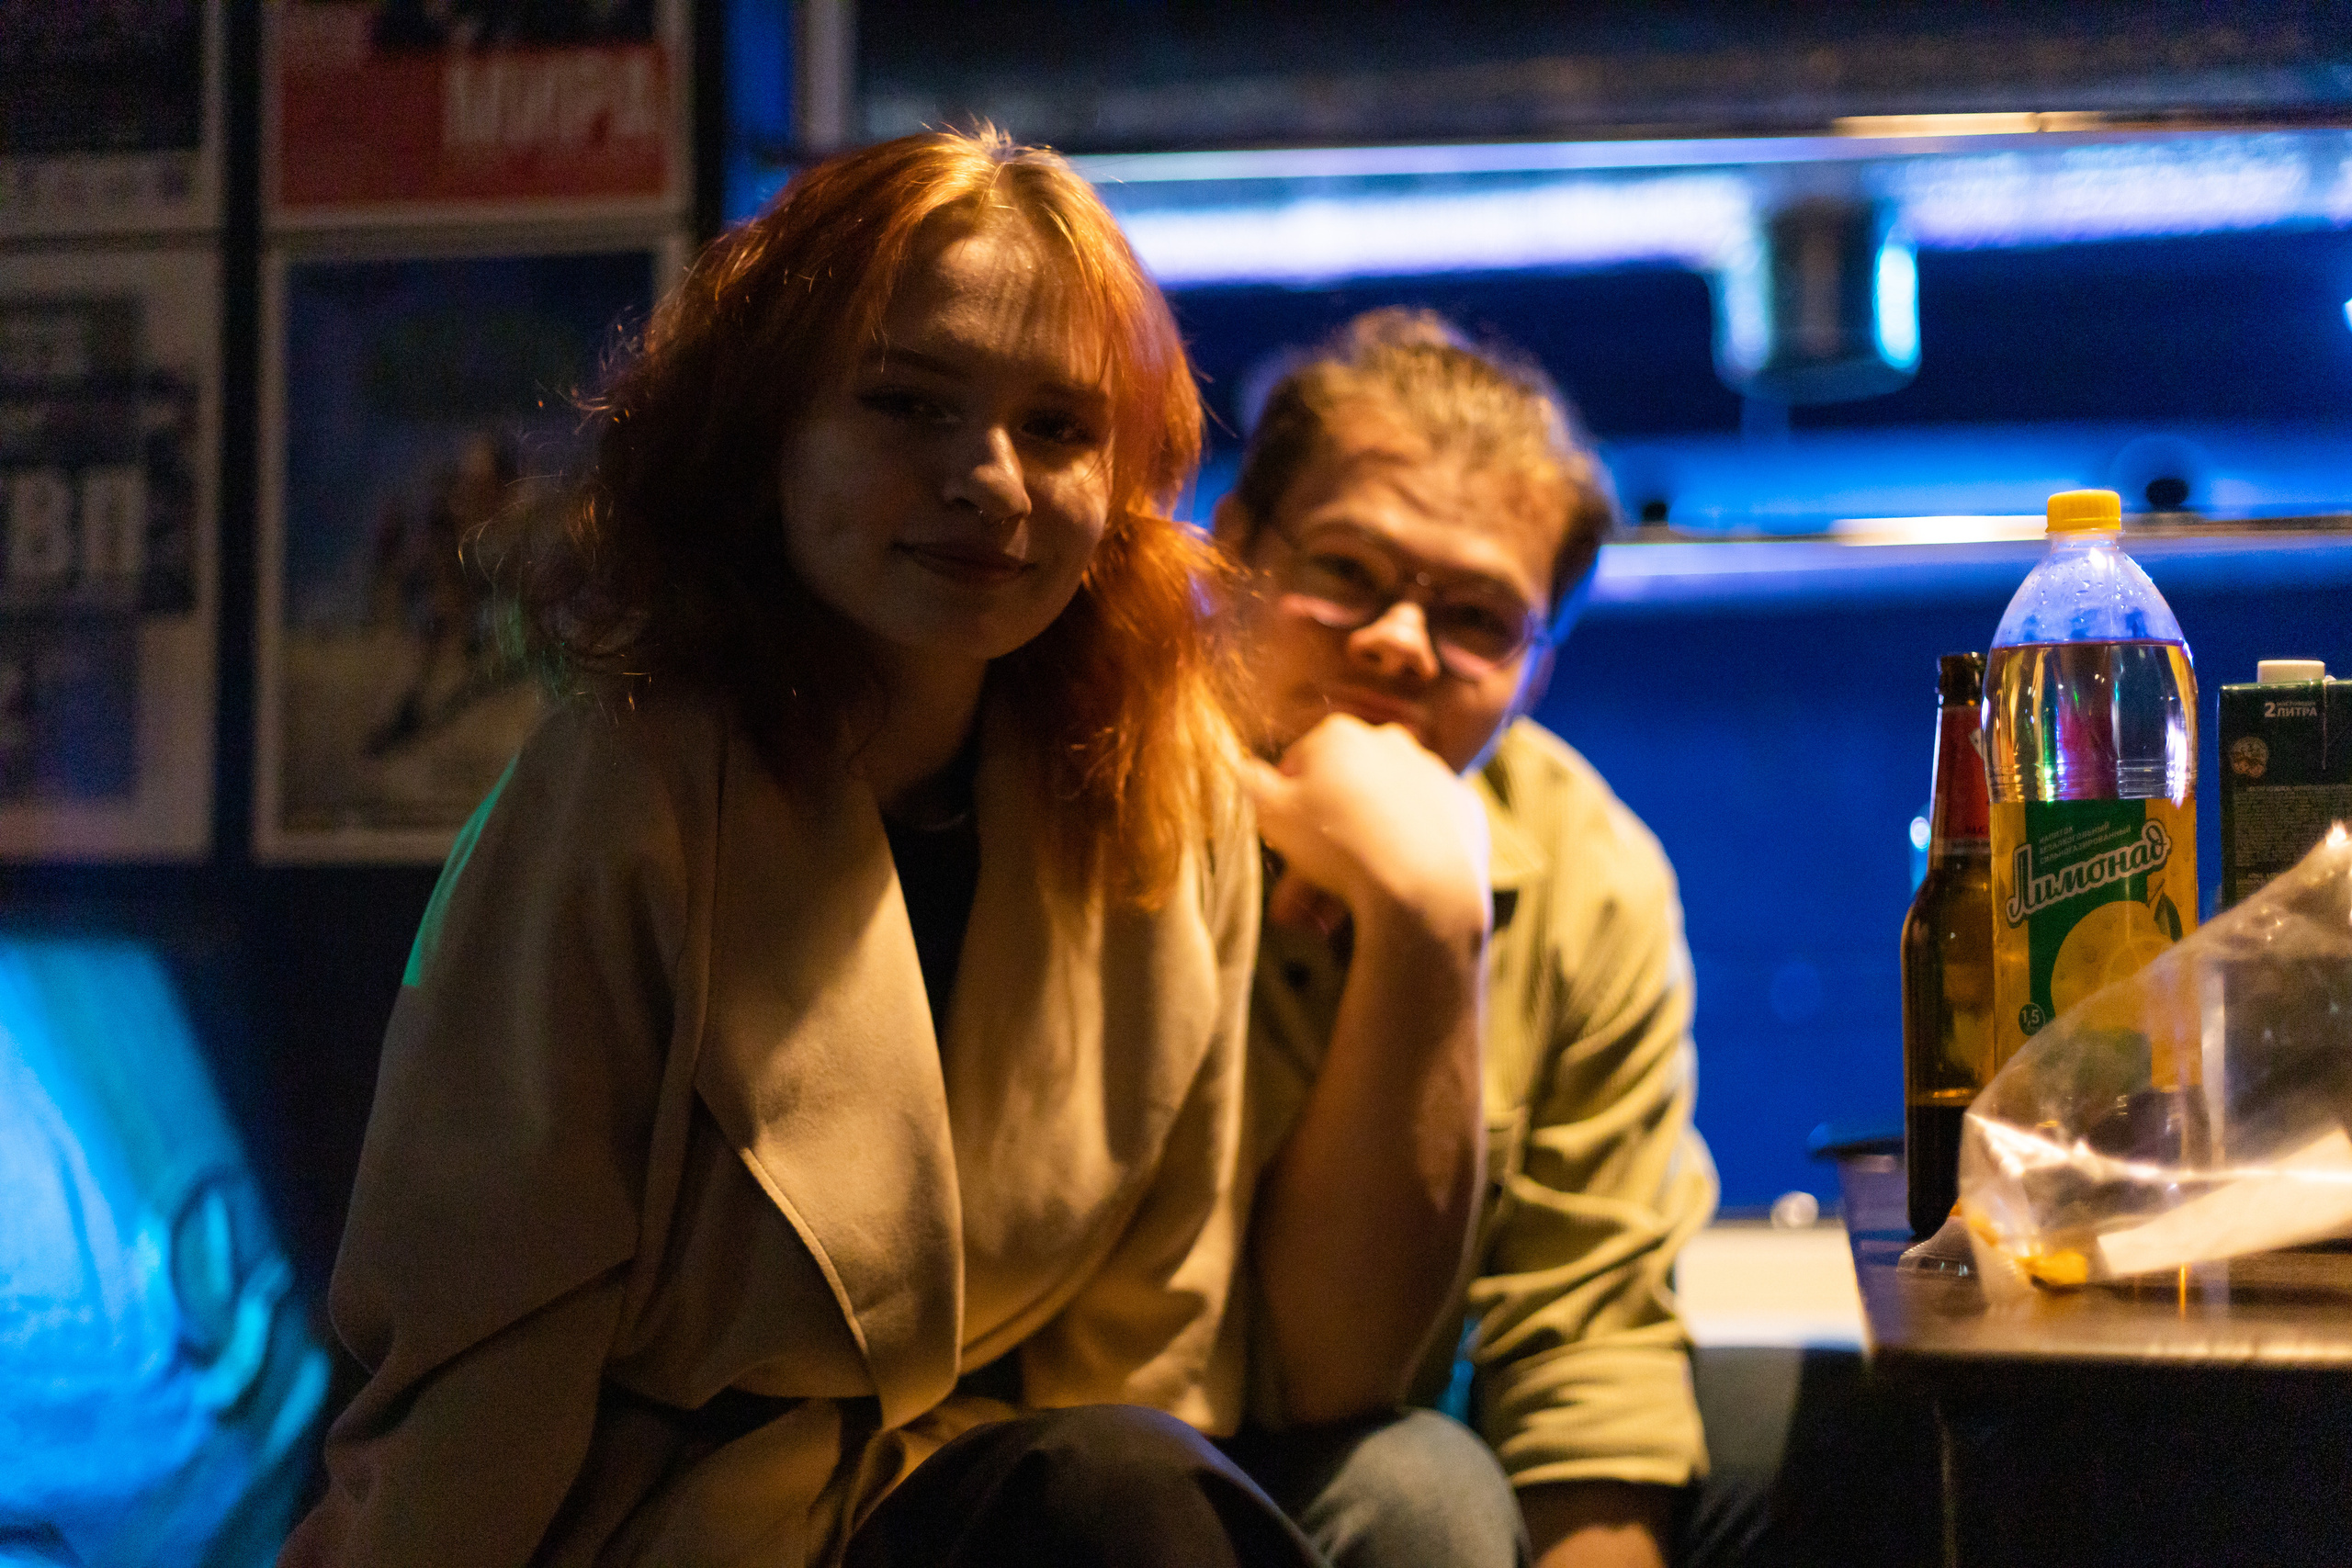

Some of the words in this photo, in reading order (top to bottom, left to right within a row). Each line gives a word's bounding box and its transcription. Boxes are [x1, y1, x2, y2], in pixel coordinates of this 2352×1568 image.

[2265, 702, 2276, 717] 2
[2277, 706, 2318, 717] ЛИТРА
[2040, 826, 2074, 843] НАПИТОК
[2040, 820, 2109, 854] БЕЗАЛКОГОЛЬНЫЙ
[2040, 824, 2132, 864] СИЛЬНОГАЗИРОВАННЫЙ
[2007, 820, 2171, 922] Лимонад
